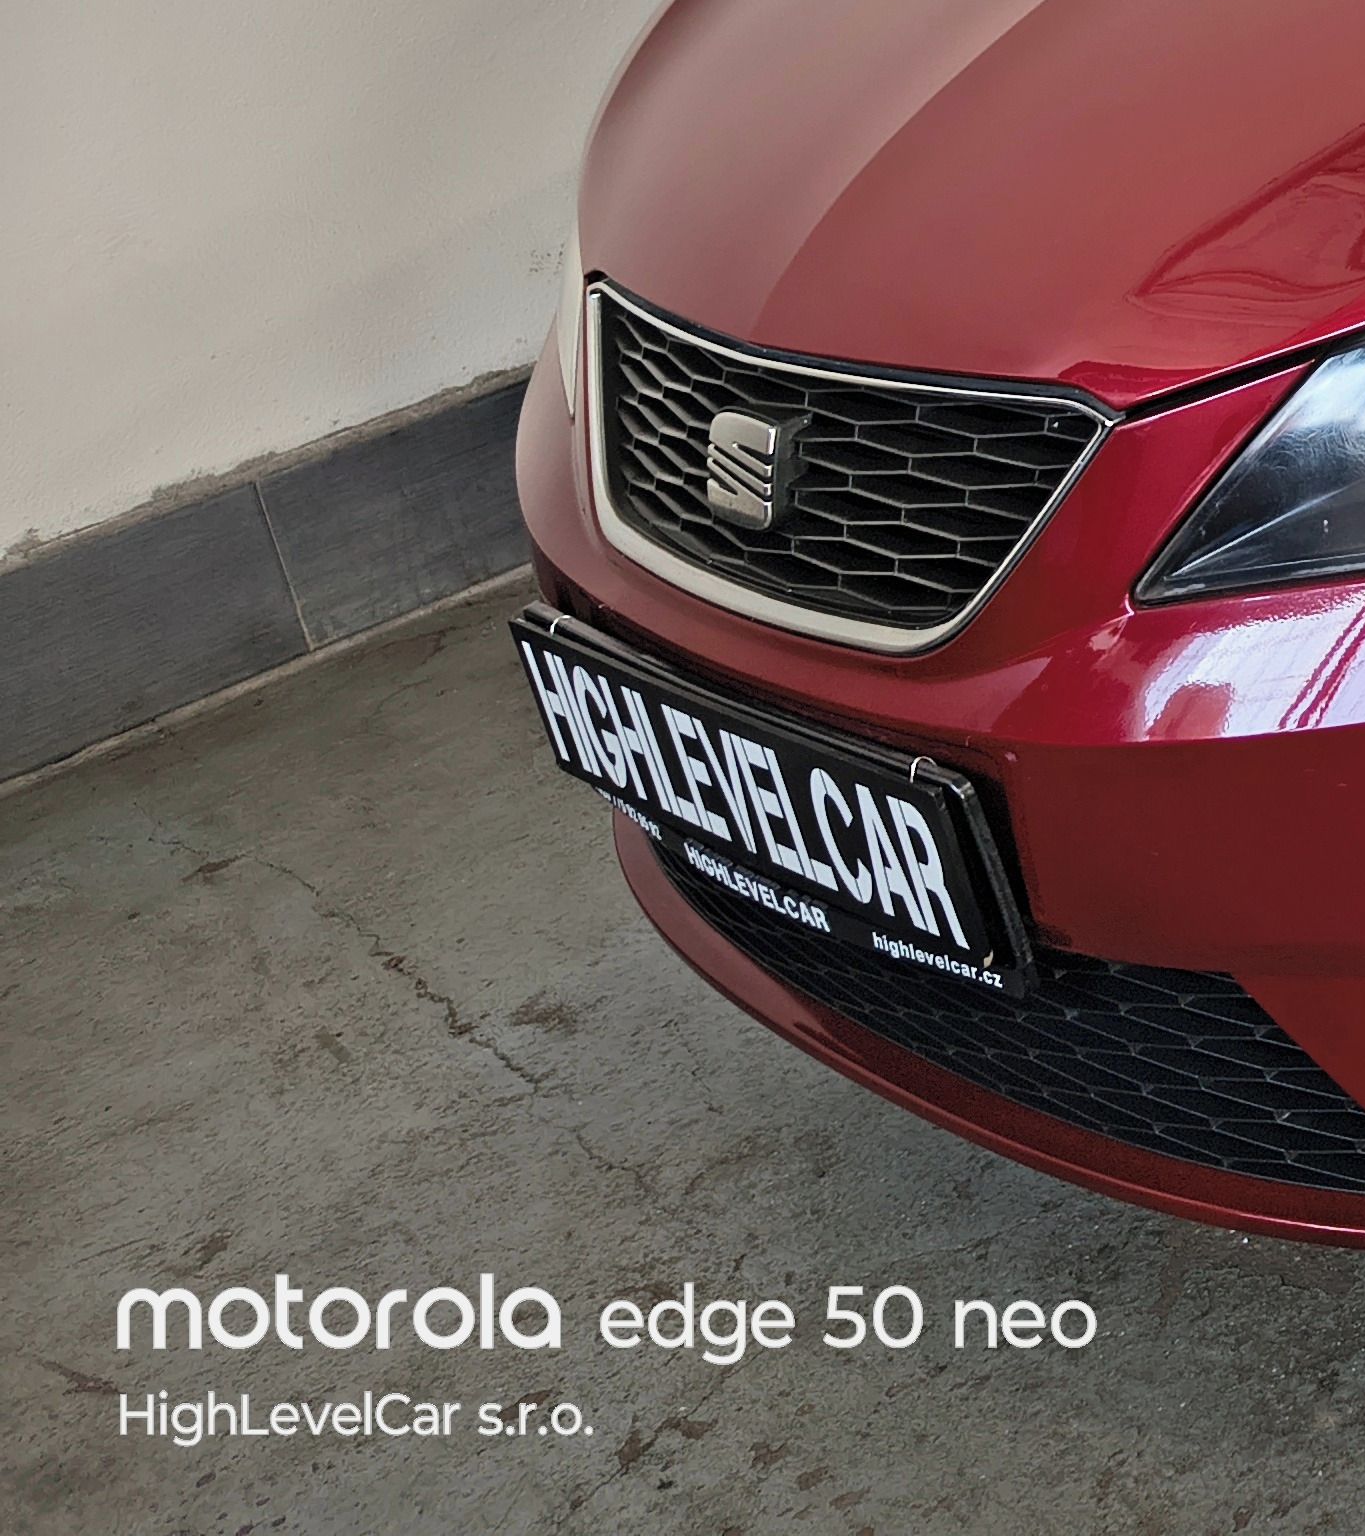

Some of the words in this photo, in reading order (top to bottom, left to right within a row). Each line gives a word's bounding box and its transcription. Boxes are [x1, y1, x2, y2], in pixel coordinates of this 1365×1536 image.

[521, 640, 970, 950] HIGHLEVELCAR
[684, 842, 831, 933] HIGHLEVELCAR
[872, 931, 1003, 989] highlevelcar.cz
